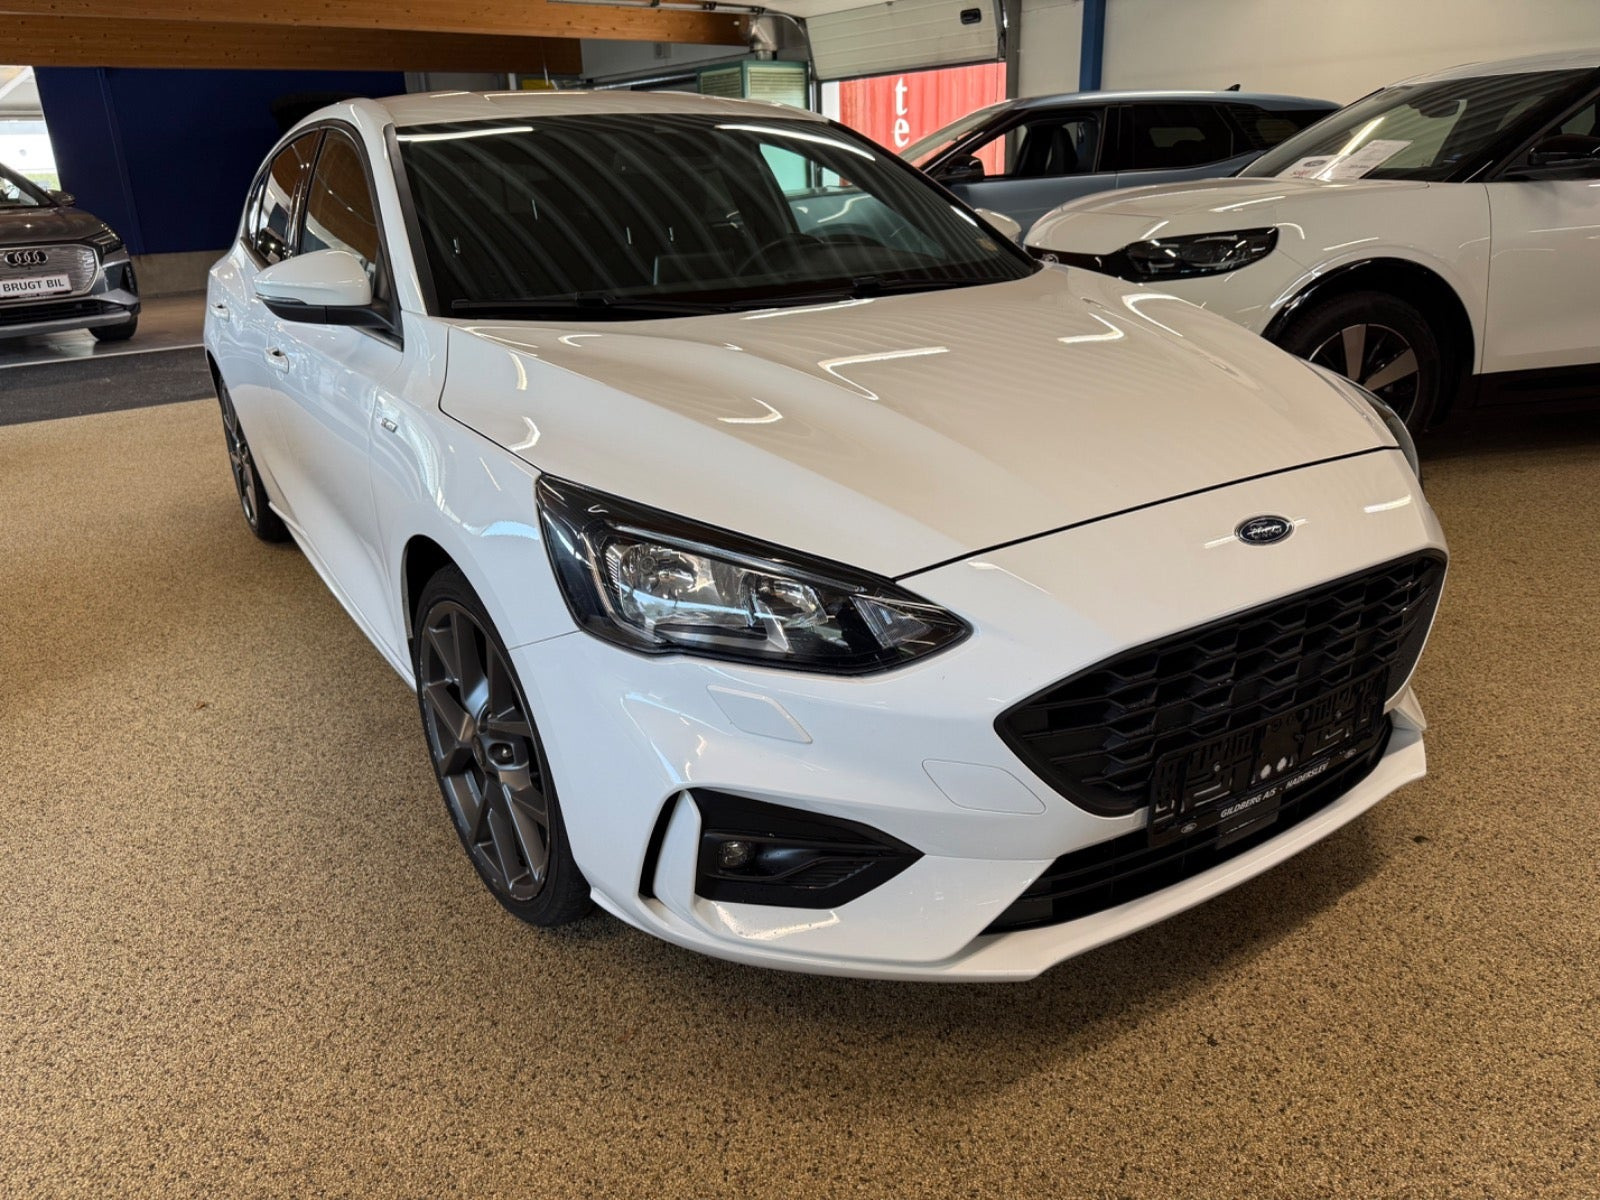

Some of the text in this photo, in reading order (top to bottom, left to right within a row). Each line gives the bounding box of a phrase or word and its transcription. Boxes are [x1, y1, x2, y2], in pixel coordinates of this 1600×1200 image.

[3, 278, 65, 292] BRUGT BIL
[1220, 793, 1262, 818] GILDBERG
